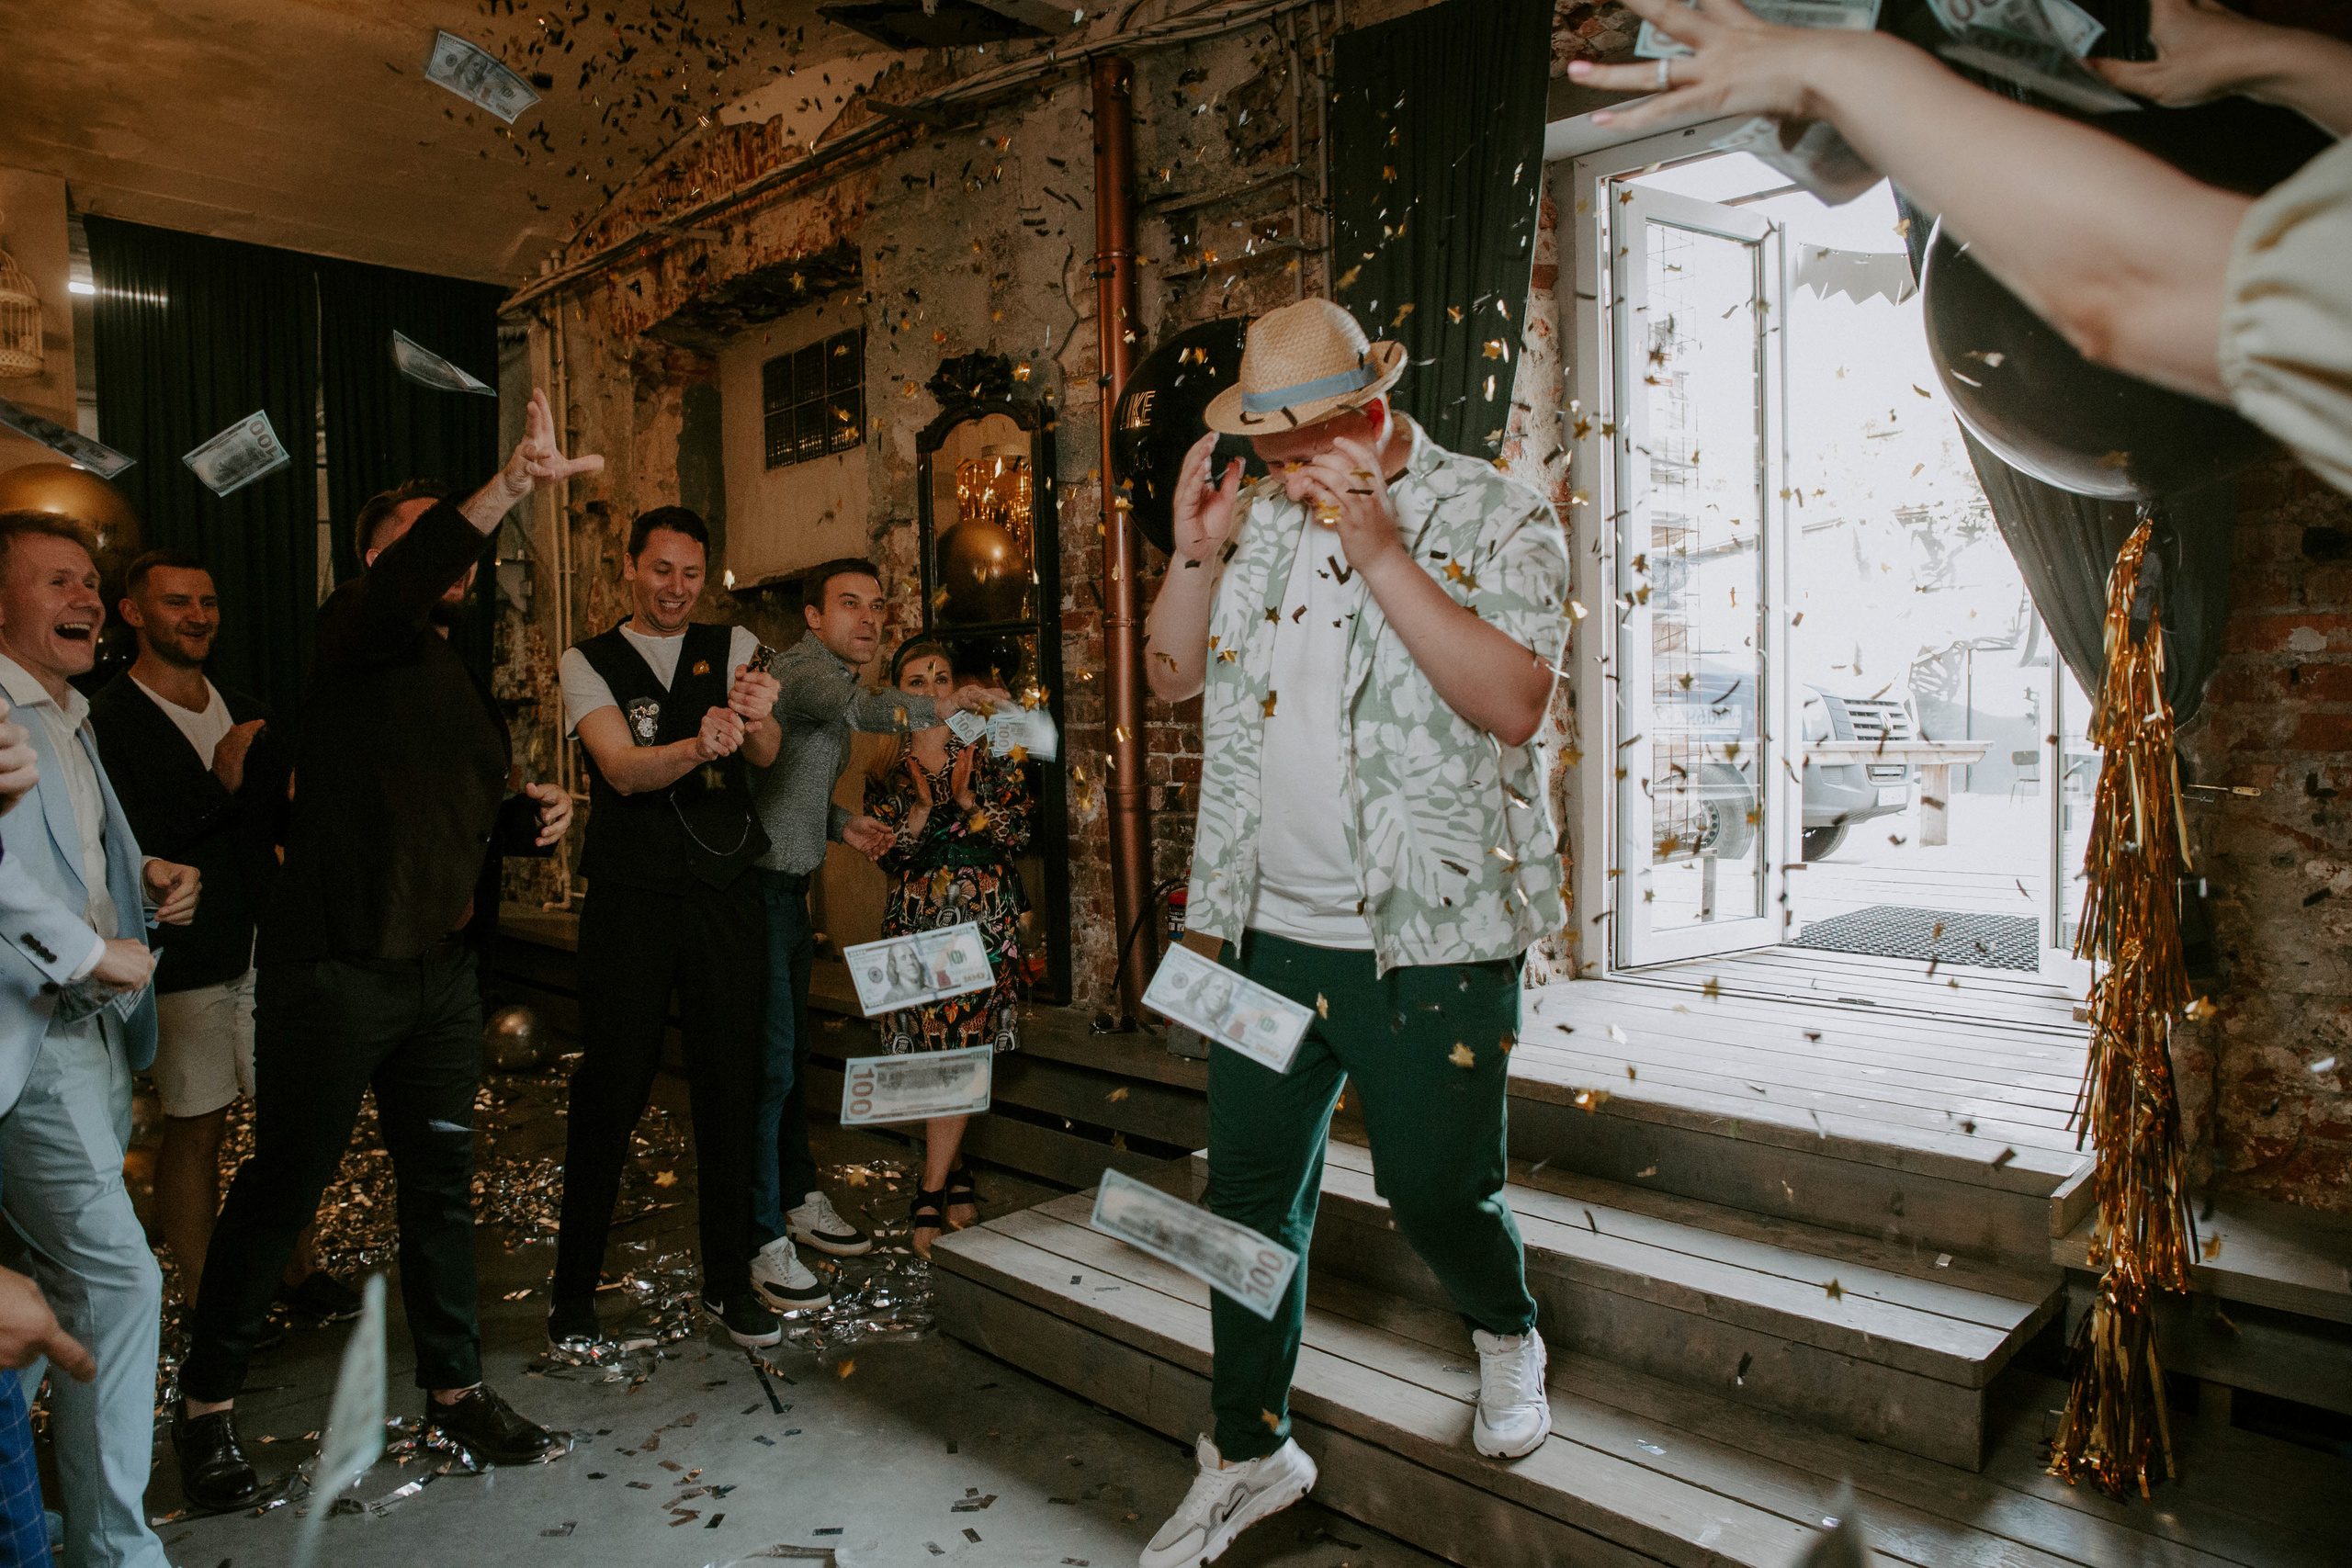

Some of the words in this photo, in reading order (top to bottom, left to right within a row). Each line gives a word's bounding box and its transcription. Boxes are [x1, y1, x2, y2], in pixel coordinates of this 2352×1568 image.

[1120, 390, 1156, 430] LIKE
[249, 420, 277, 457] 100
[955, 716, 975, 739] 100
[998, 724, 1011, 749] 100
[849, 1067, 875, 1115] 100
[1245, 1249, 1283, 1300] 100
